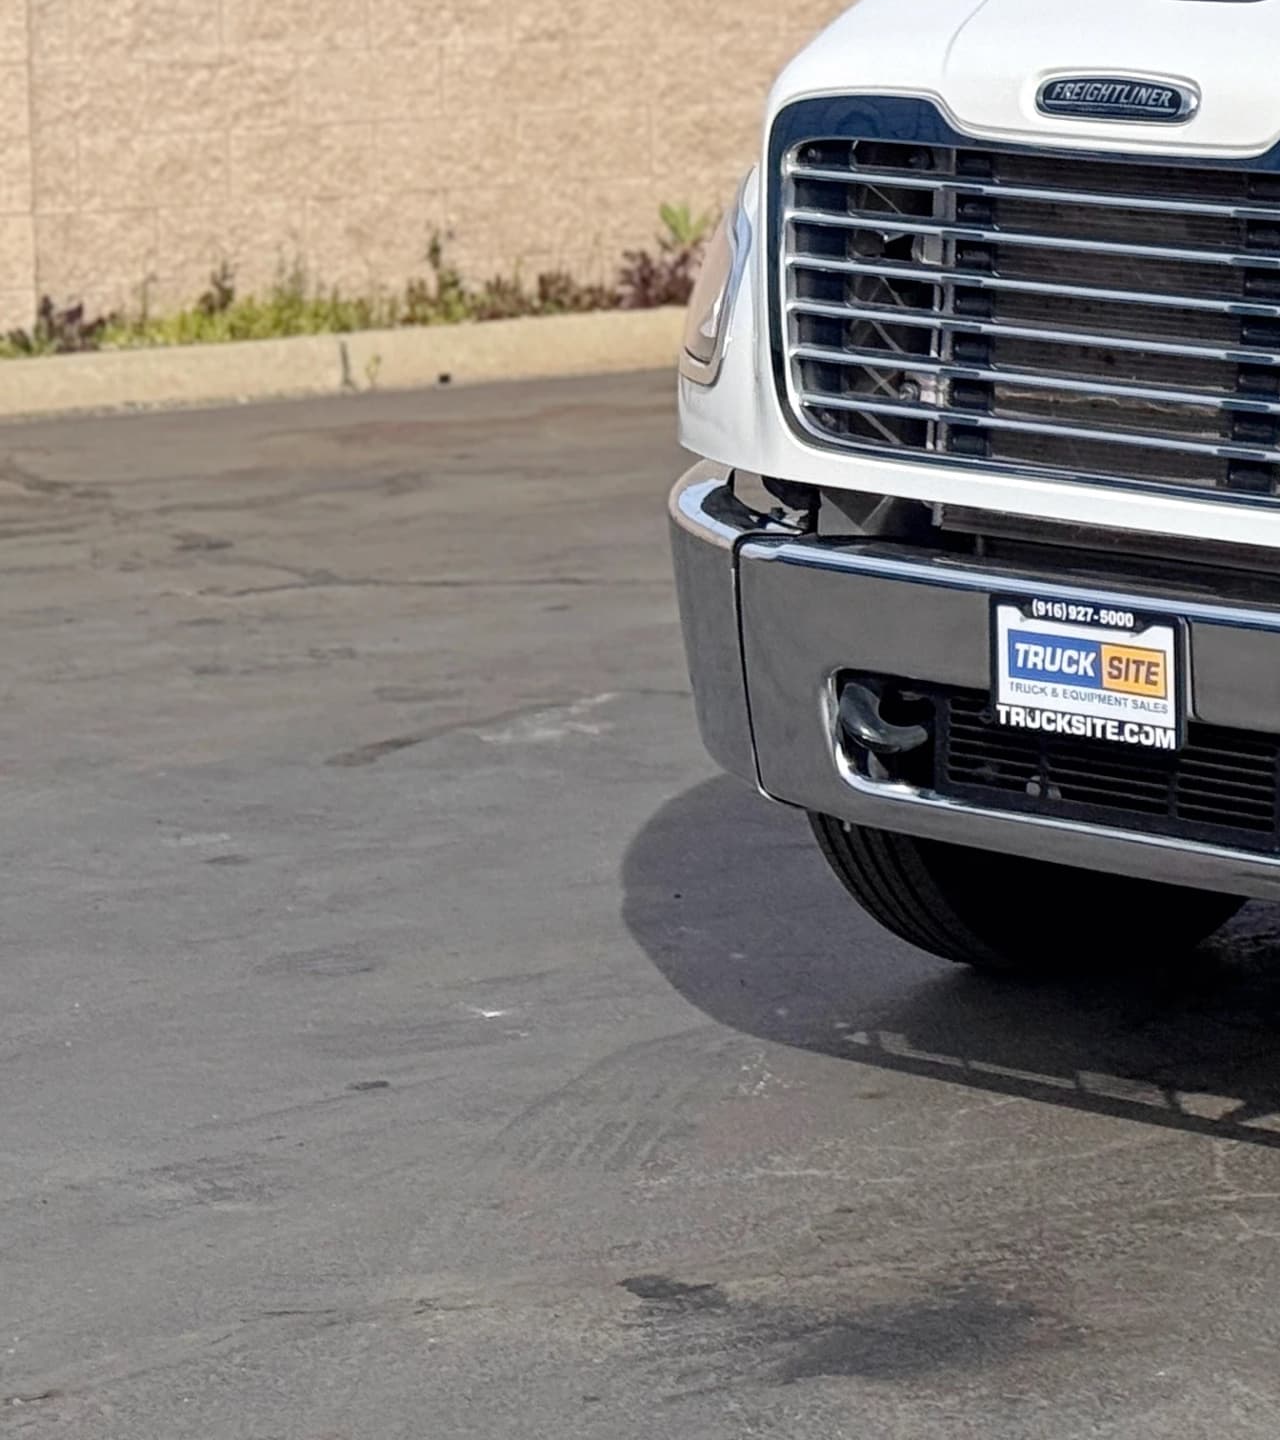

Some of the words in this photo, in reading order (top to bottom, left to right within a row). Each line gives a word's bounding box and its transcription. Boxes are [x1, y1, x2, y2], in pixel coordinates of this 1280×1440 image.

[1051, 82, 1173, 107] FREIGHTLINER
[1014, 642, 1097, 677] TRUCK
[1107, 655, 1160, 687] SITE
[1010, 681, 1048, 697] TRUCK
[1051, 688, 1059, 698] &
[1063, 689, 1128, 707] EQUIPMENT
[1131, 699, 1168, 714] SALES
[996, 704, 1176, 750] TRUCKSITE.COM
